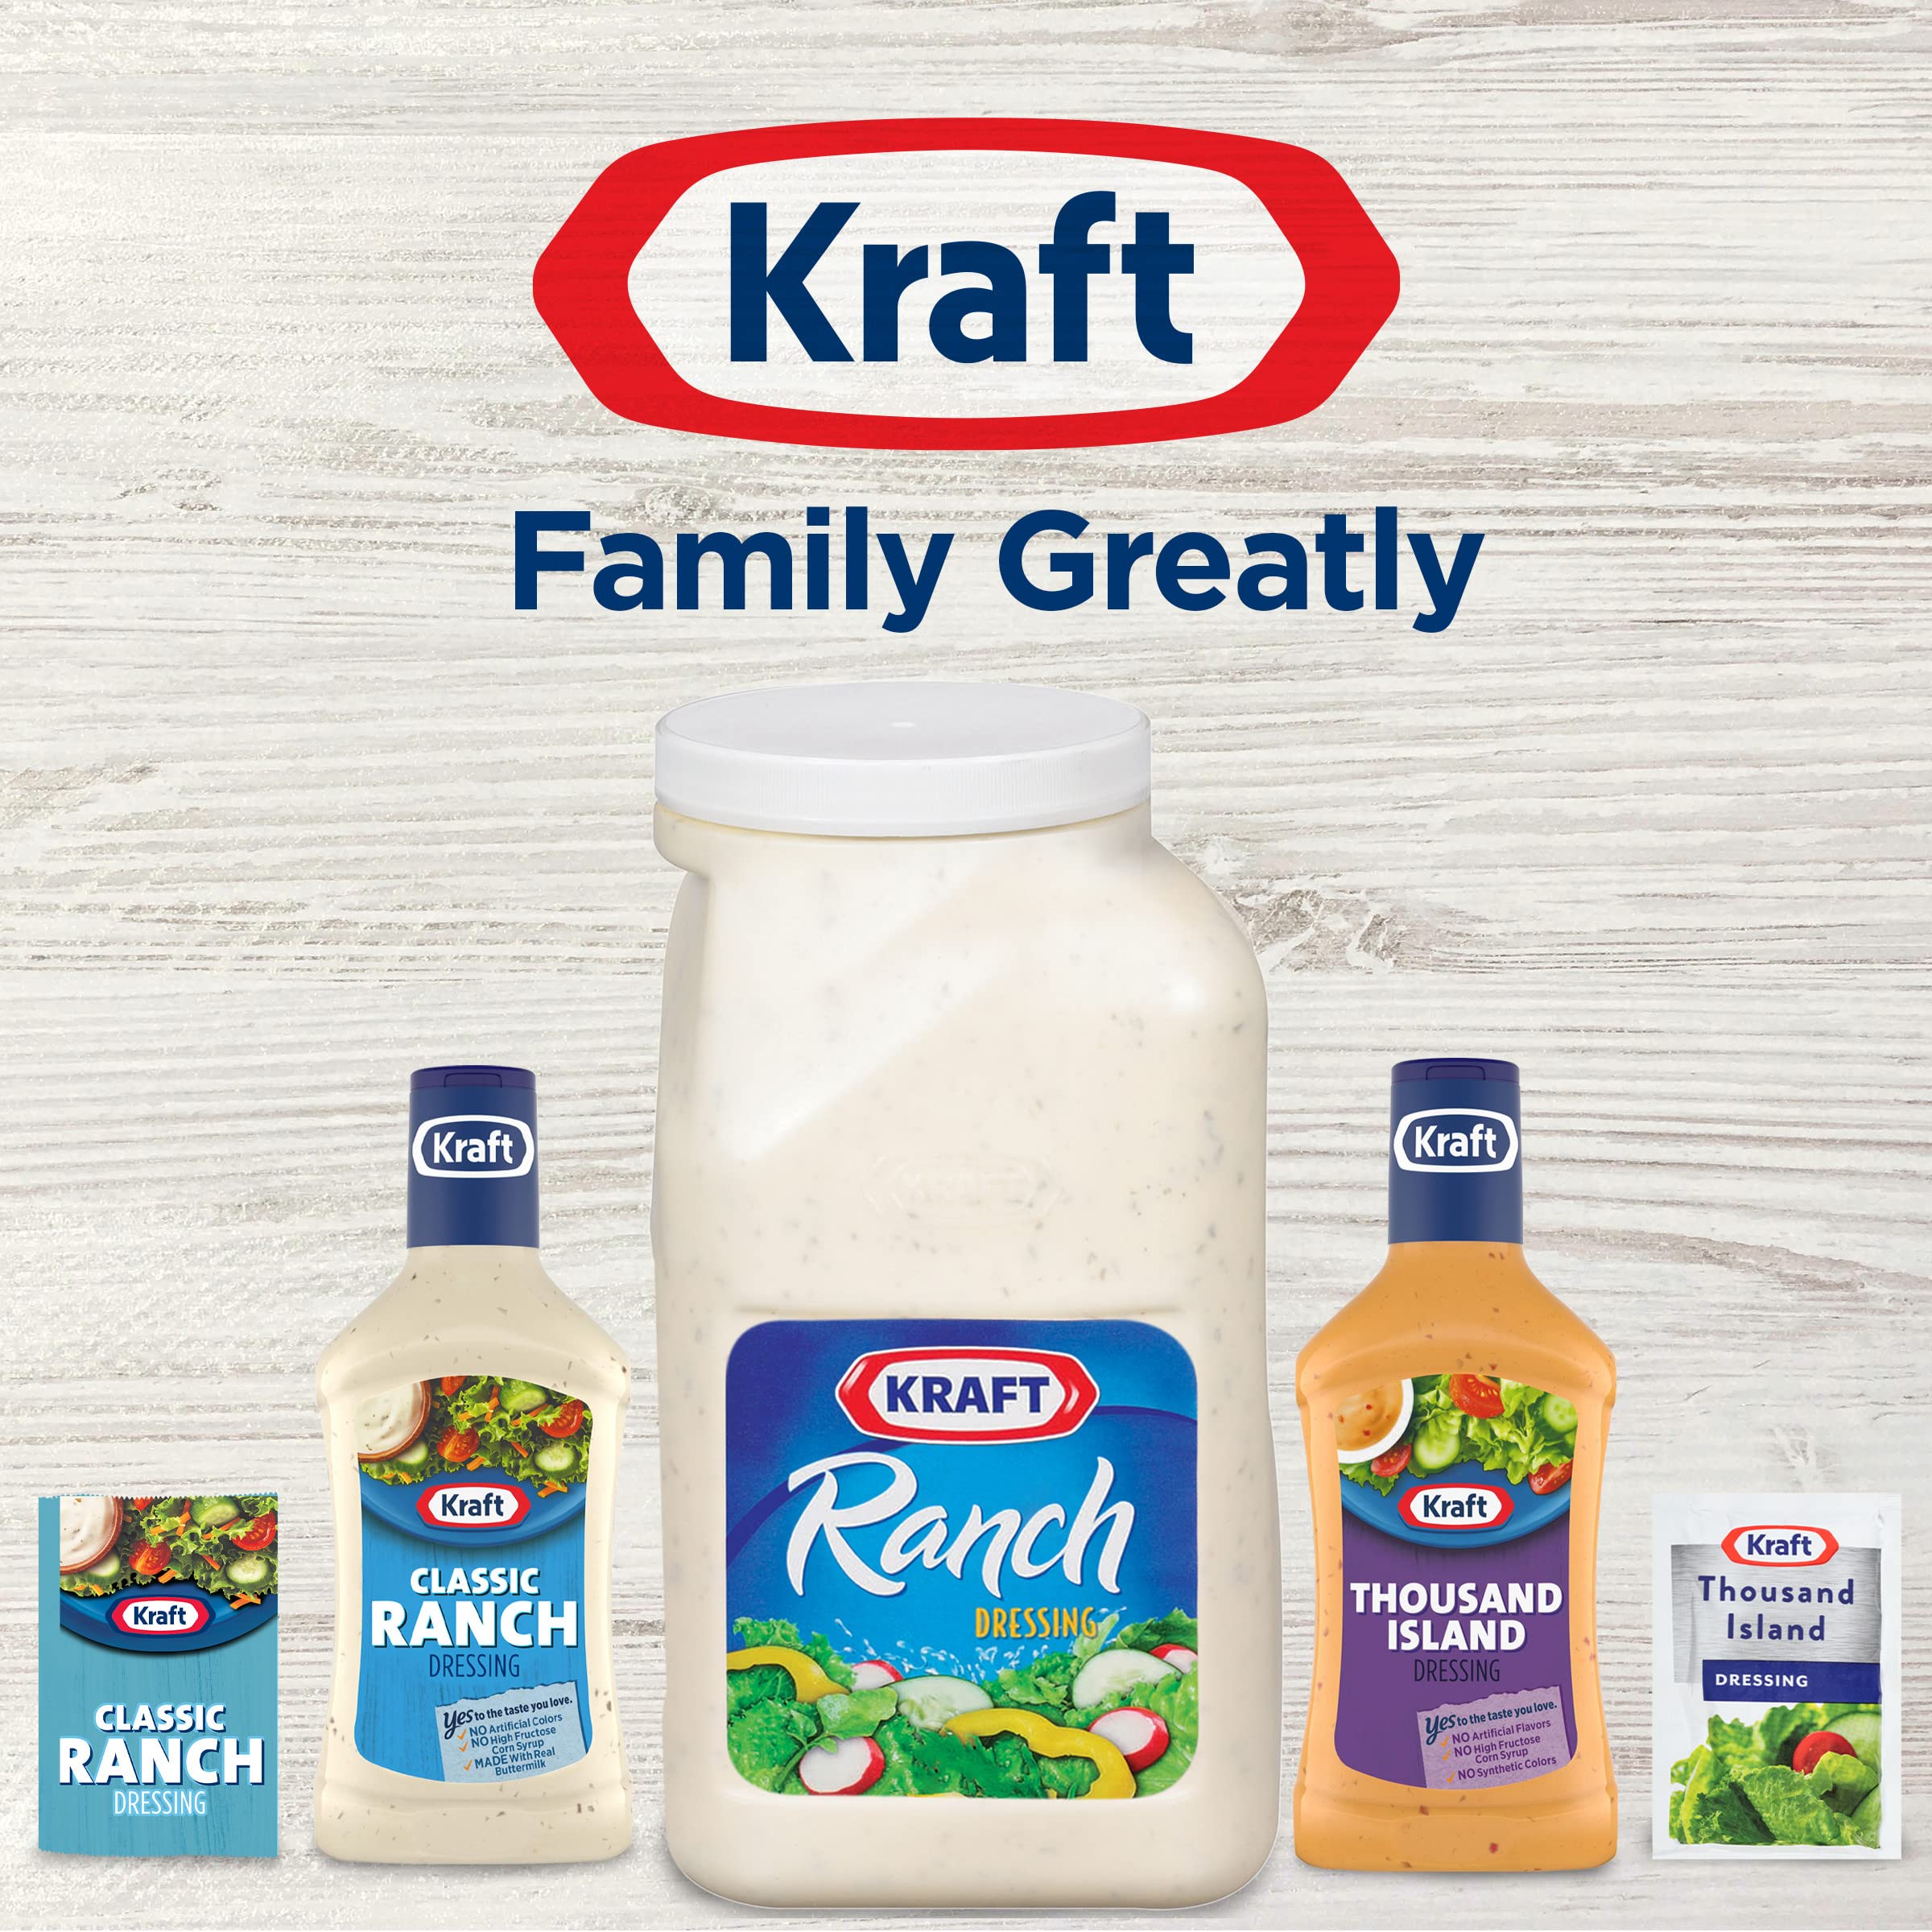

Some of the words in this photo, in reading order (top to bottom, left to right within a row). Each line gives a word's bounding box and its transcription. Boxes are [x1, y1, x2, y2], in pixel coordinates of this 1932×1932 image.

[433, 1129, 513, 1164] Kraft
[1415, 1124, 1496, 1158] Kraft
[885, 1374, 1051, 1415] KRAFT
[442, 1492, 504, 1517] Kraft
[1423, 1493, 1487, 1517] Kraft
[786, 1451, 1135, 1599] Ranch
[1747, 1533, 1812, 1557] Kraft
[411, 1568, 540, 1595] CLASSIC
[1698, 1575, 1854, 1605] Thousand
[1350, 1582, 1563, 1614] THOUSAND
[134, 1605, 187, 1625] Kraft
[371, 1600, 578, 1647] RANCH
[975, 1608, 1100, 1639] DRESSING
[1727, 1613, 1826, 1641] Island
[1388, 1620, 1526, 1651] ISLAND
[429, 1653, 520, 1678] DRESSING
[1414, 1659, 1501, 1682] DRESSING
[1715, 1674, 1808, 1687] DRESSING
[95, 1704, 226, 1732] CLASSIC
[475, 1712, 485, 1721] to
[487, 1708, 502, 1719] the
[505, 1703, 529, 1715] taste
[531, 1700, 548, 1713] you
[550, 1696, 572, 1707] love.
[1457, 1716, 1468, 1726] to
[1469, 1714, 1486, 1724] the
[1487, 1709, 1513, 1721] taste
[1514, 1706, 1532, 1718] you
[1534, 1701, 1557, 1712] love.
[469, 1725, 487, 1737] NO
[489, 1718, 530, 1734] Artificial
[533, 1713, 563, 1726] Colors
[472, 1736, 489, 1748] NO
[491, 1733, 513, 1745] High
[514, 1726, 556, 1740] Fructose
[1452, 1733, 1470, 1744] NO
[1472, 1725, 1514, 1741] Artificial
[1516, 1719, 1551, 1732] Flavors
[475, 1755, 508, 1769] MADE
[510, 1751, 533, 1763] With
[534, 1747, 555, 1758] Real
[492, 1744, 514, 1755] Corn
[517, 1739, 544, 1752] Syrup
[1454, 1745, 1472, 1757] NO
[1474, 1742, 1496, 1754] High
[1498, 1735, 1541, 1749] Fructose
[1476, 1752, 1498, 1764] Corn
[1501, 1748, 1528, 1761] Syrup
[60, 1738, 265, 1785] RANCH
[495, 1760, 546, 1776] Buttermilk
[1458, 1769, 1475, 1780] NO
[1477, 1762, 1522, 1777] Synthetic
[1525, 1757, 1557, 1769] Colors
[114, 1790, 206, 1815] DRESSING
